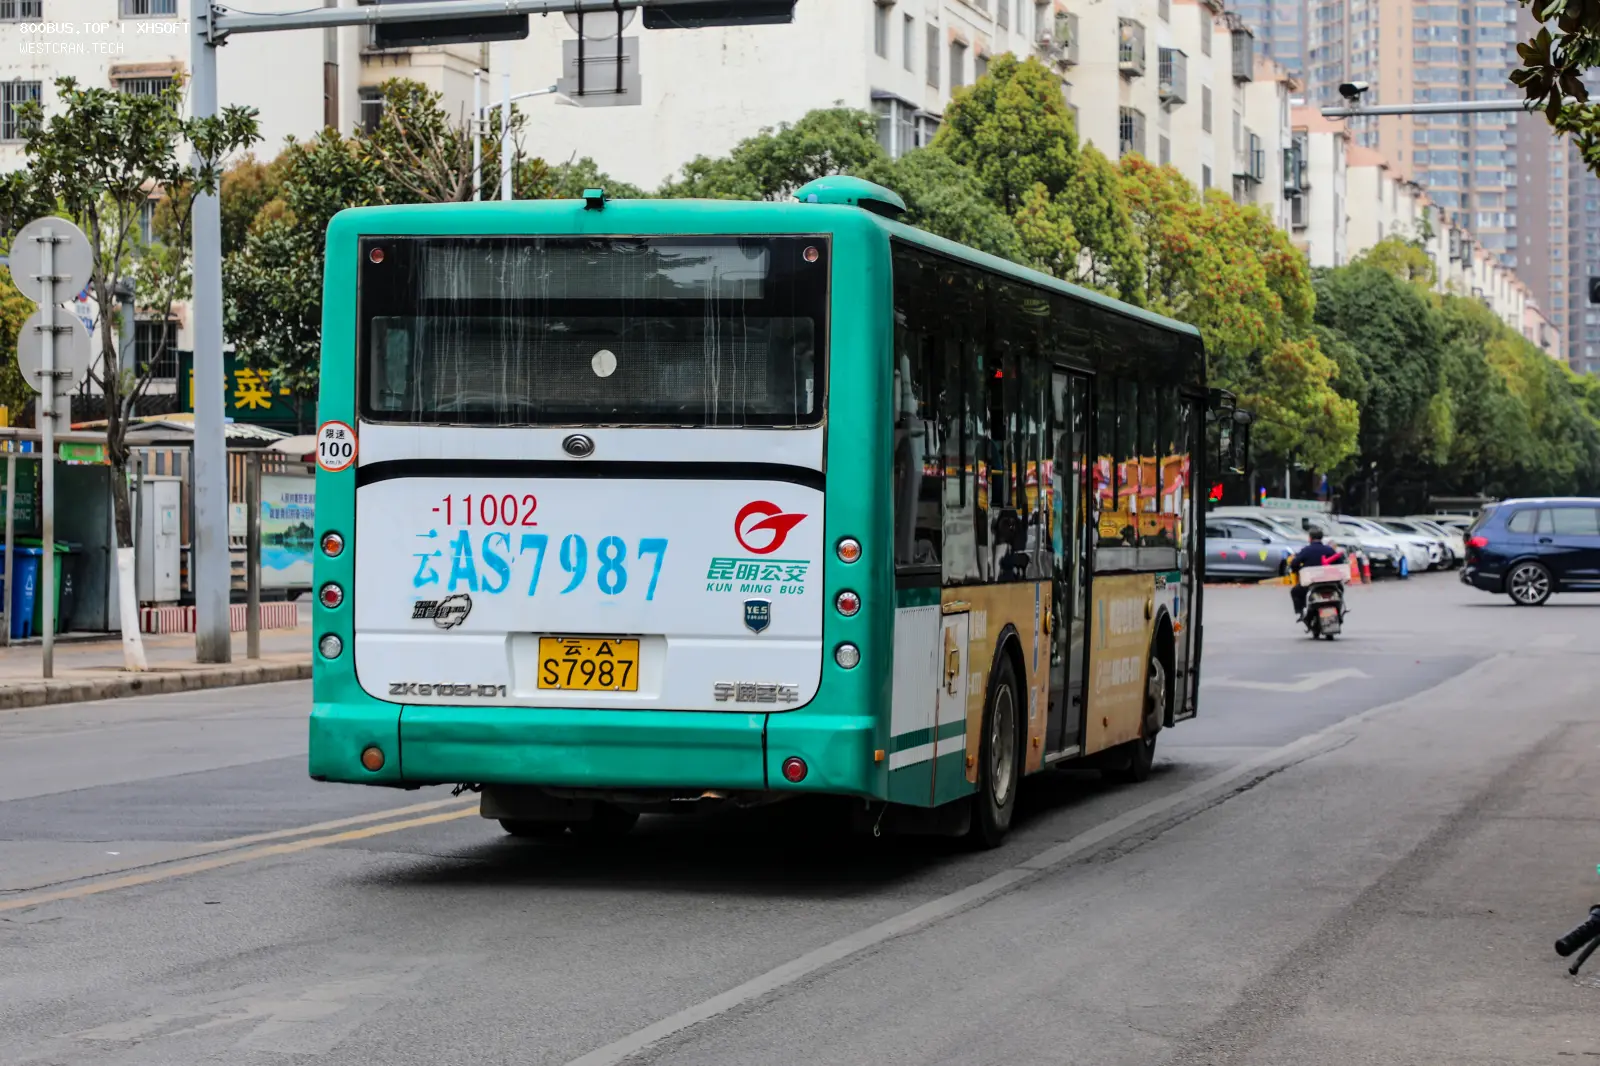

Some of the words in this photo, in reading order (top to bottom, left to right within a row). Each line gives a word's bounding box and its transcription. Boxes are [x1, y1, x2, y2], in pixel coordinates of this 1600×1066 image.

[325, 428, 345, 439] 限速
[319, 441, 352, 457] 100
[706, 557, 810, 582] 昆明公交
[706, 582, 732, 592] KUN
[740, 584, 772, 593] MING
[779, 585, 804, 594] BUS
[746, 606, 768, 614] YES
[543, 658, 633, 687] S7987
